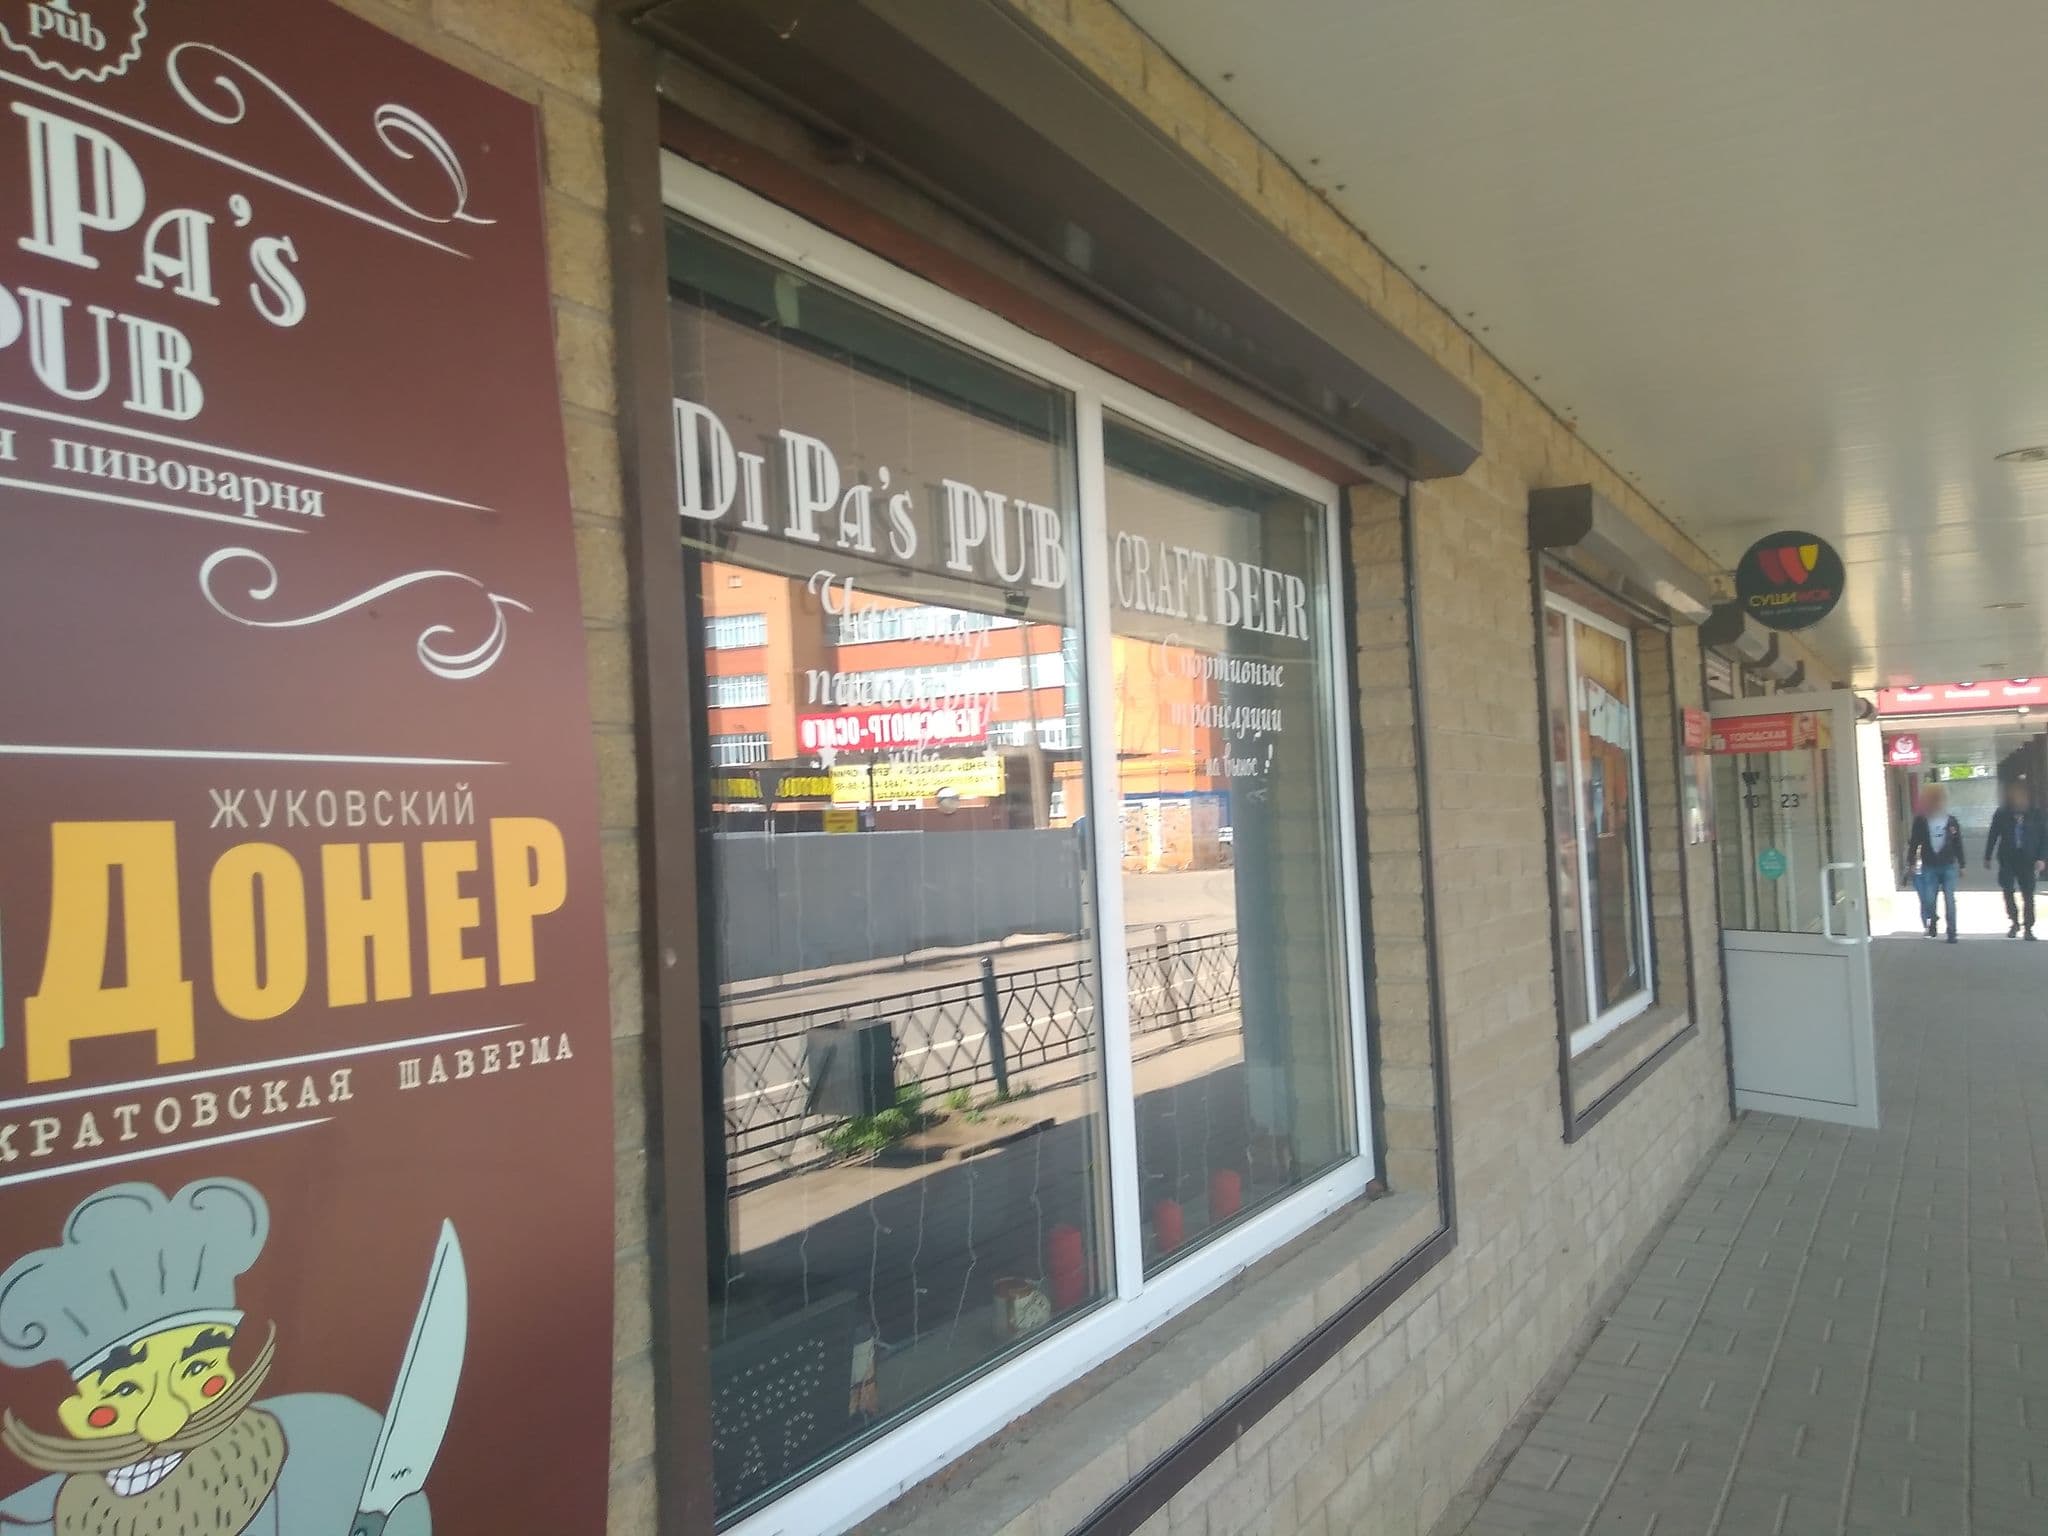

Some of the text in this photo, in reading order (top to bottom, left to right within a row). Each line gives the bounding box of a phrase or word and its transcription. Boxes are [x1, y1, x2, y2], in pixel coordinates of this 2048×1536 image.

[27, 2, 107, 52] pub
[50, 437, 326, 519] пивоварня
[942, 478, 1067, 590] PUB
[209, 783, 475, 829] ЖУКОВСКИЙ
[24, 816, 568, 1084] ДОНЕР
[398, 1032, 574, 1090] ШАВЕРМА
